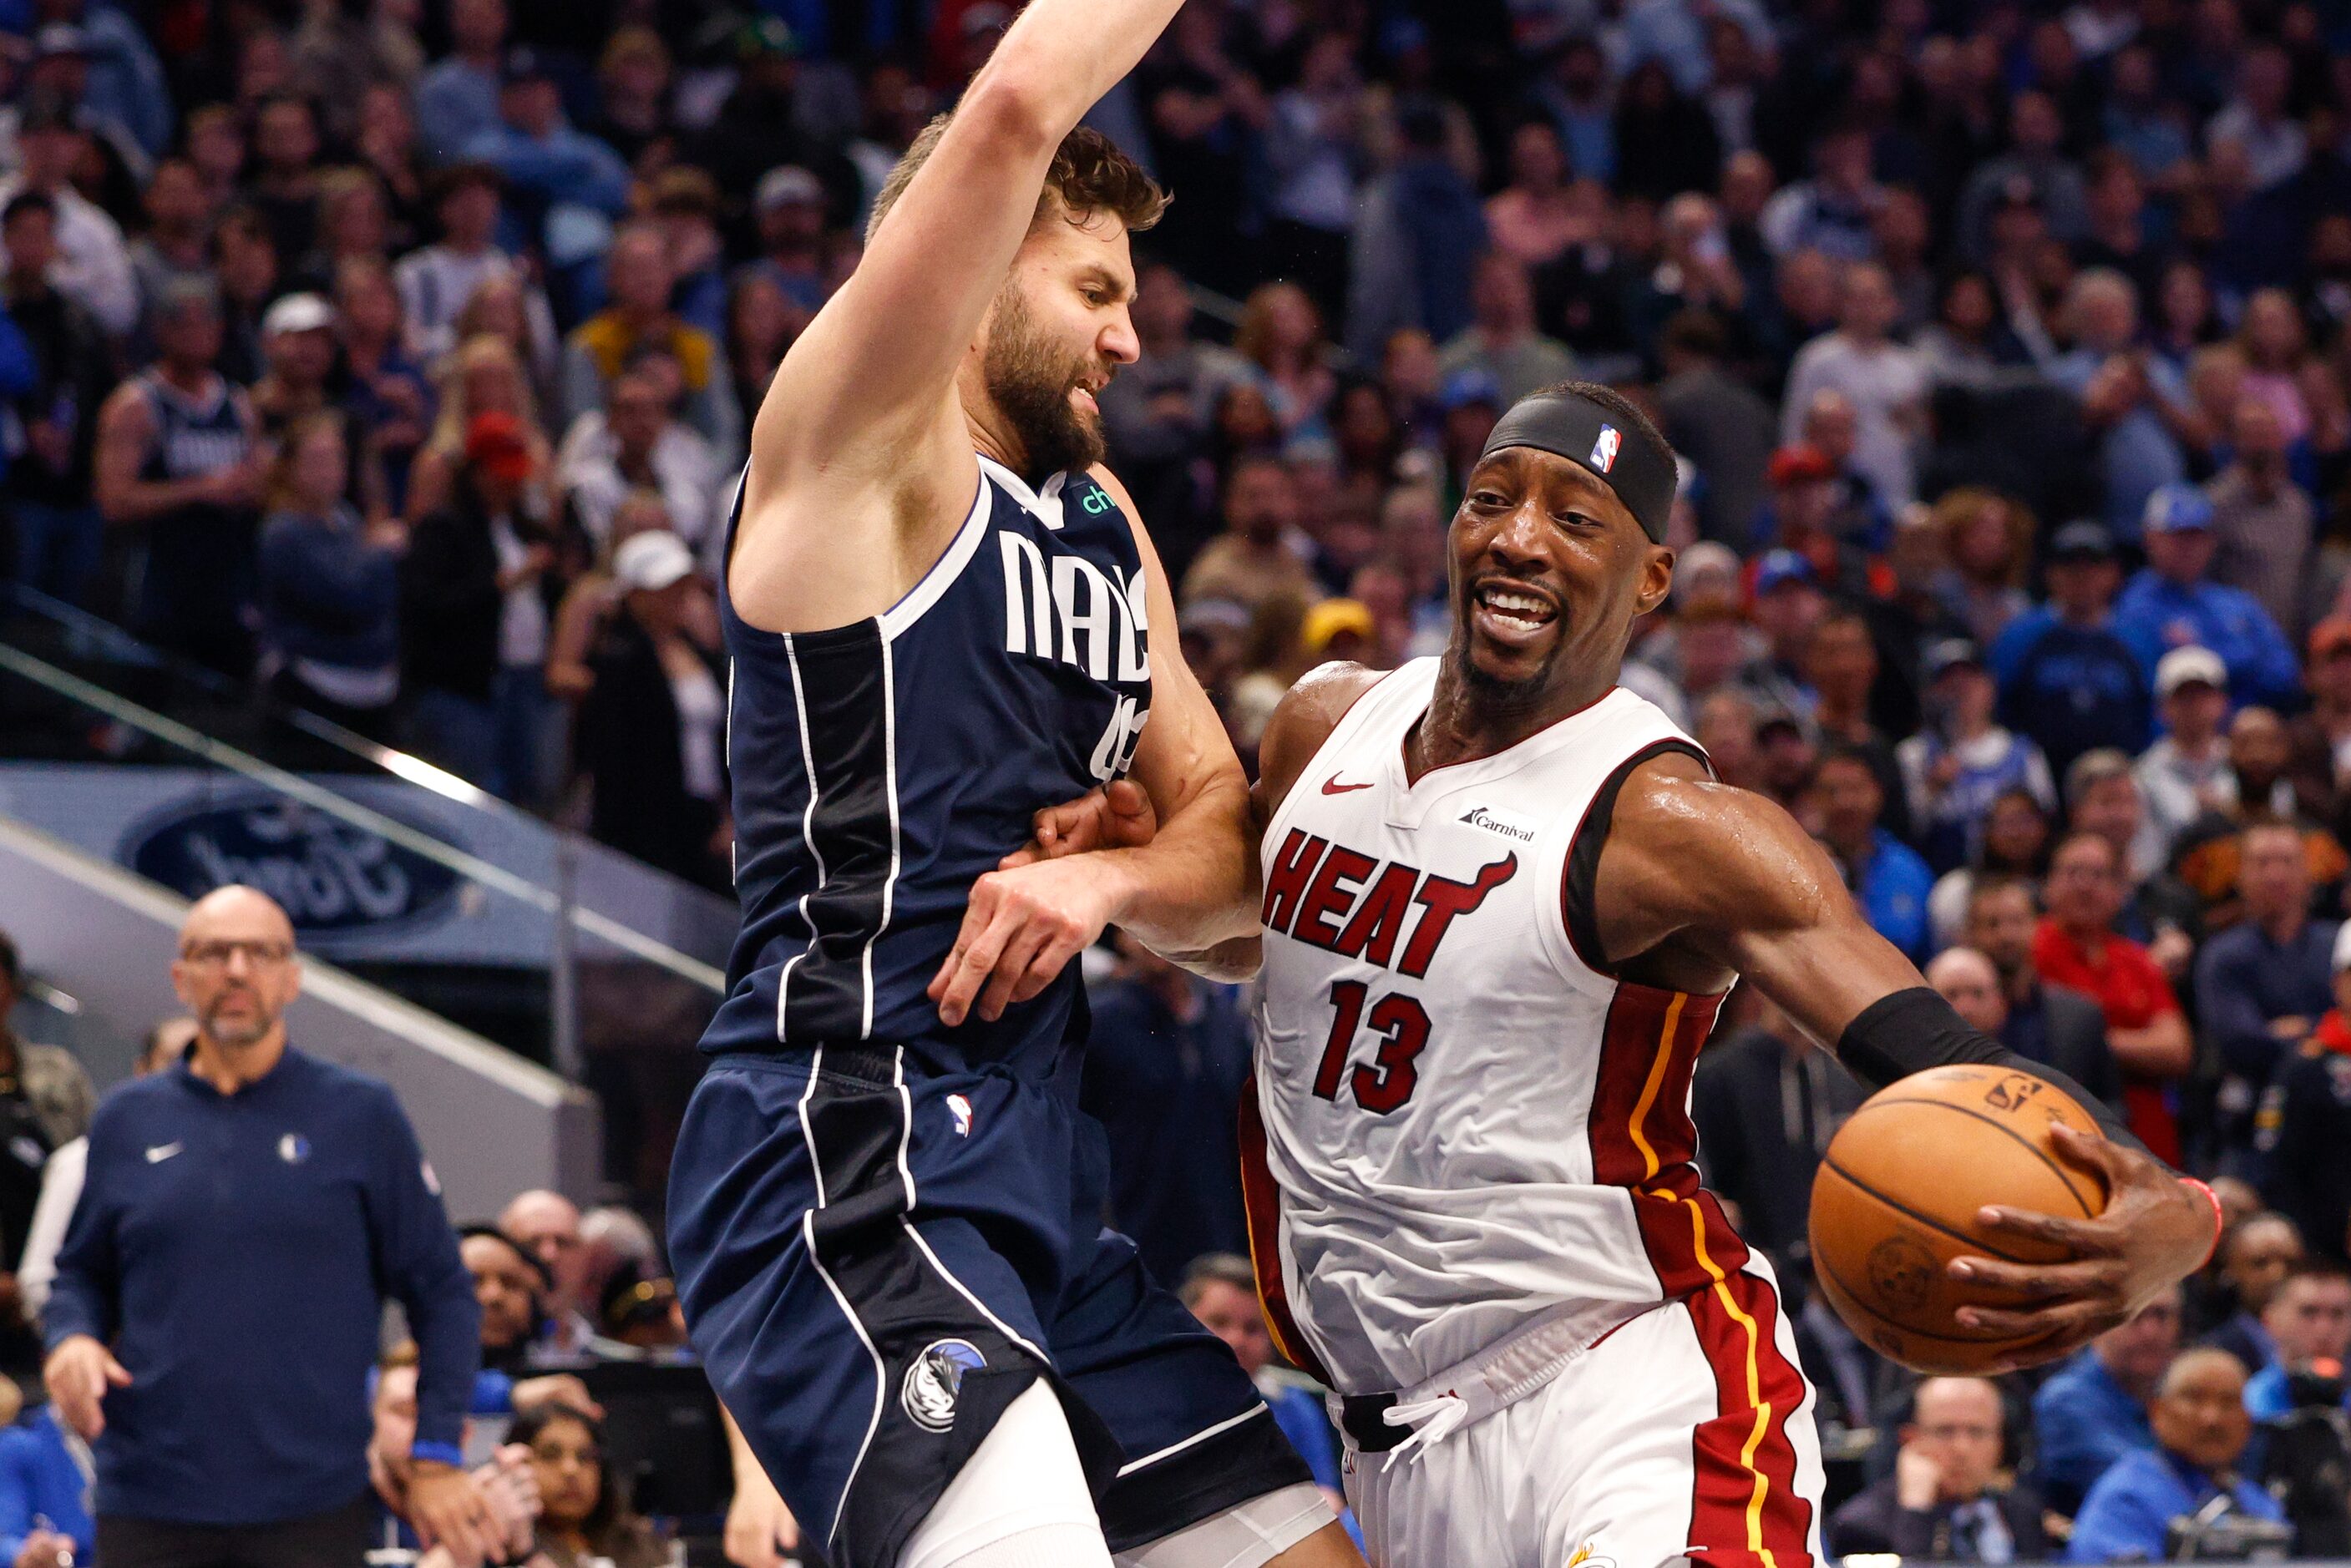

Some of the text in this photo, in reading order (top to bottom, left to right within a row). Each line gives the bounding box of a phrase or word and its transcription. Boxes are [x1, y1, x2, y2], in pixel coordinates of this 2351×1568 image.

[1475, 815, 1535, 842] Carnival
[1260, 827, 1518, 980] HEAT
[1312, 979, 1432, 1116] 13
